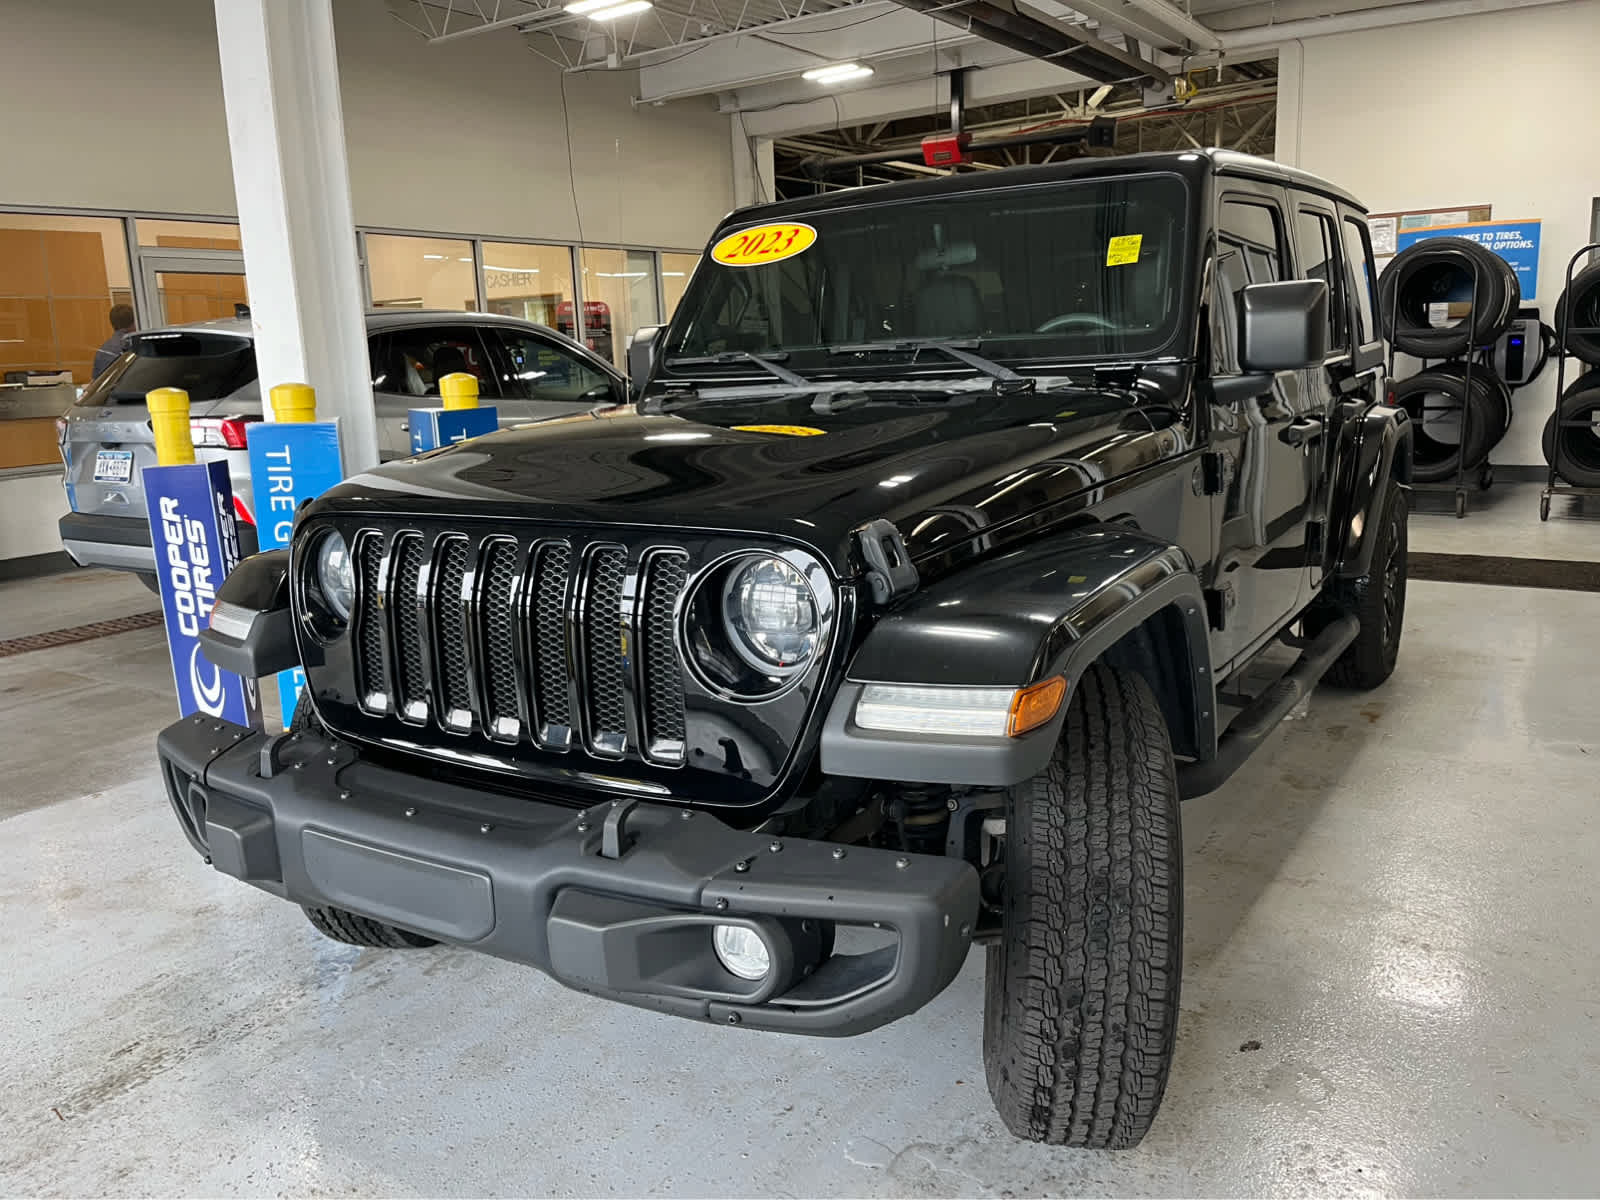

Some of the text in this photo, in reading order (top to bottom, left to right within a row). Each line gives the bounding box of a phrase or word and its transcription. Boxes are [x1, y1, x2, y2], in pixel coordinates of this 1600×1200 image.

[724, 228, 800, 259] 2023
[1482, 232, 1494, 241] TO
[1495, 230, 1523, 241] TIRES,
[1493, 240, 1534, 250] OPTIONS.
[486, 271, 533, 289] CASHIER
[265, 444, 297, 512] TIRE
[159, 496, 200, 638] COOPER
[185, 517, 216, 619] TIRES
